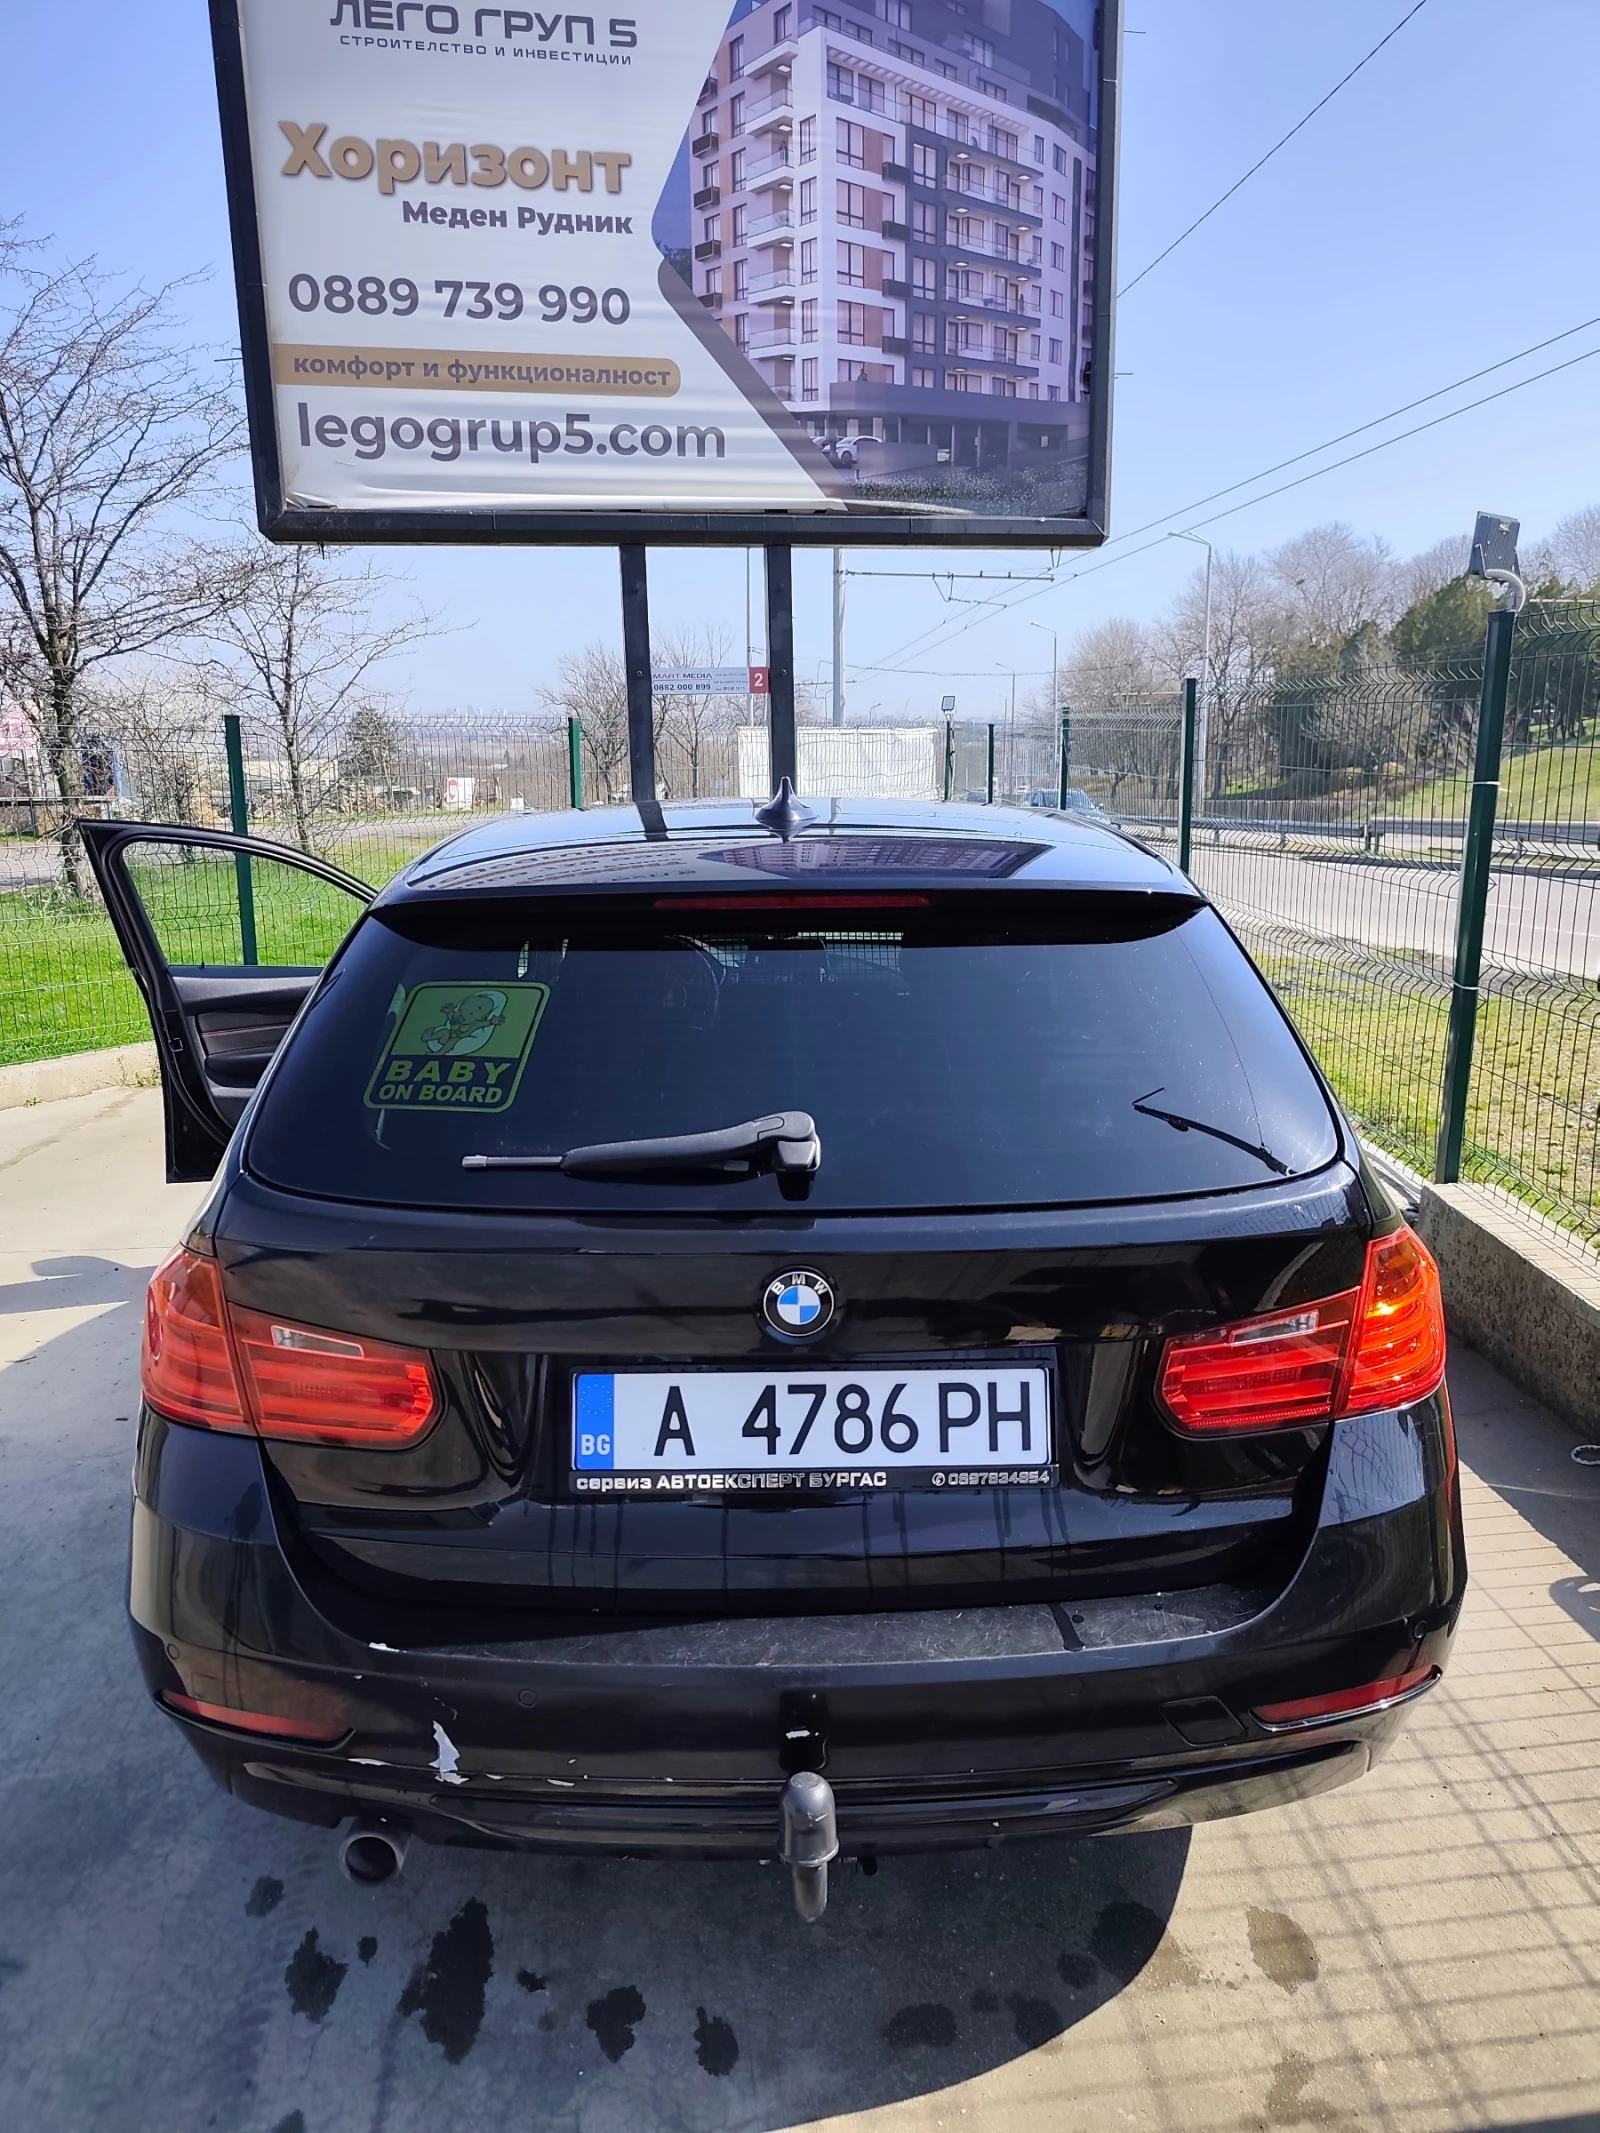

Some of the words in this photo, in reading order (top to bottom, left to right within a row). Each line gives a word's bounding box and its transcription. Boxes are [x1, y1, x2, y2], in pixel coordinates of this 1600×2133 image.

[330, 0, 459, 35] ЛЕГО
[474, 8, 595, 46] ГРУП
[609, 18, 638, 48] 5
[340, 35, 487, 56] СТРОИТЕЛСТВО
[495, 46, 505, 57] И
[513, 47, 632, 66] ИНВЕСТИЦИИ
[278, 120, 631, 195] Хоризонт
[402, 201, 507, 231] Меден
[517, 206, 634, 236] Рудник
[288, 273, 419, 316] 0889
[434, 279, 524, 322] 739
[538, 284, 631, 325] 990
[293, 354, 415, 381] комфорт
[423, 360, 439, 378] и
[447, 358, 671, 387] функционалност
[297, 402, 726, 464] legogrup5.com
[653, 683, 675, 691] 0882
[677, 683, 693, 691] 000
[695, 683, 711, 691] 899
[754, 673, 764, 687] 2
[385, 1060, 512, 1085] BABY
[378, 1084, 413, 1100] ON
[418, 1085, 502, 1104] BOARD
[770, 1274, 828, 1295] BMW
[654, 1385, 696, 1457] A
[742, 1383, 919, 1456] 4786
[580, 1434, 611, 1456] BG
[576, 1476, 652, 1492] сервиз
[655, 1472, 805, 1490] АВТОЕКСПЕРТ
[809, 1471, 888, 1488] БУРГАС
